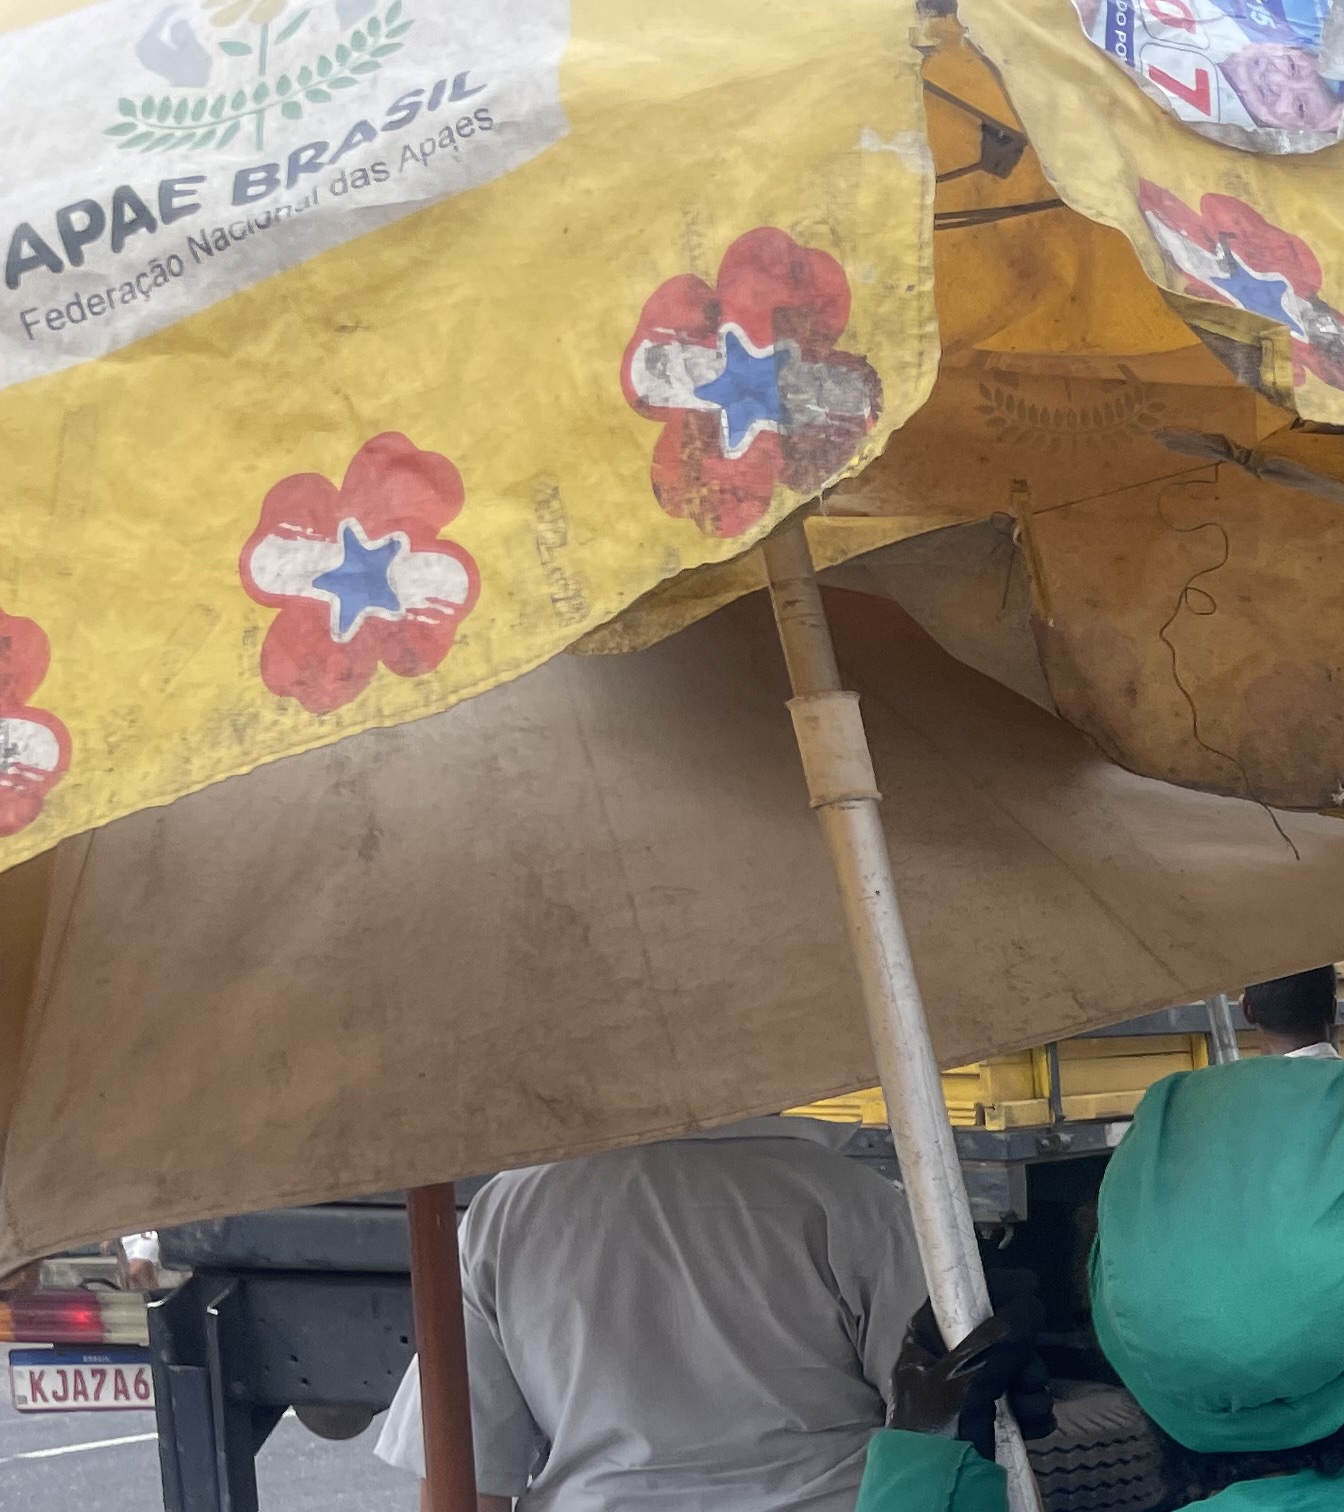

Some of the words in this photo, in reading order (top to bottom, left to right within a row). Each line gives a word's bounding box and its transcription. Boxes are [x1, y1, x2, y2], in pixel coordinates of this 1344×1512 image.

[5, 175, 207, 289] APAE
[232, 71, 487, 206] BRASIL
[19, 253, 186, 340] Federação
[330, 160, 391, 198] das
[400, 108, 495, 173] Apaes
